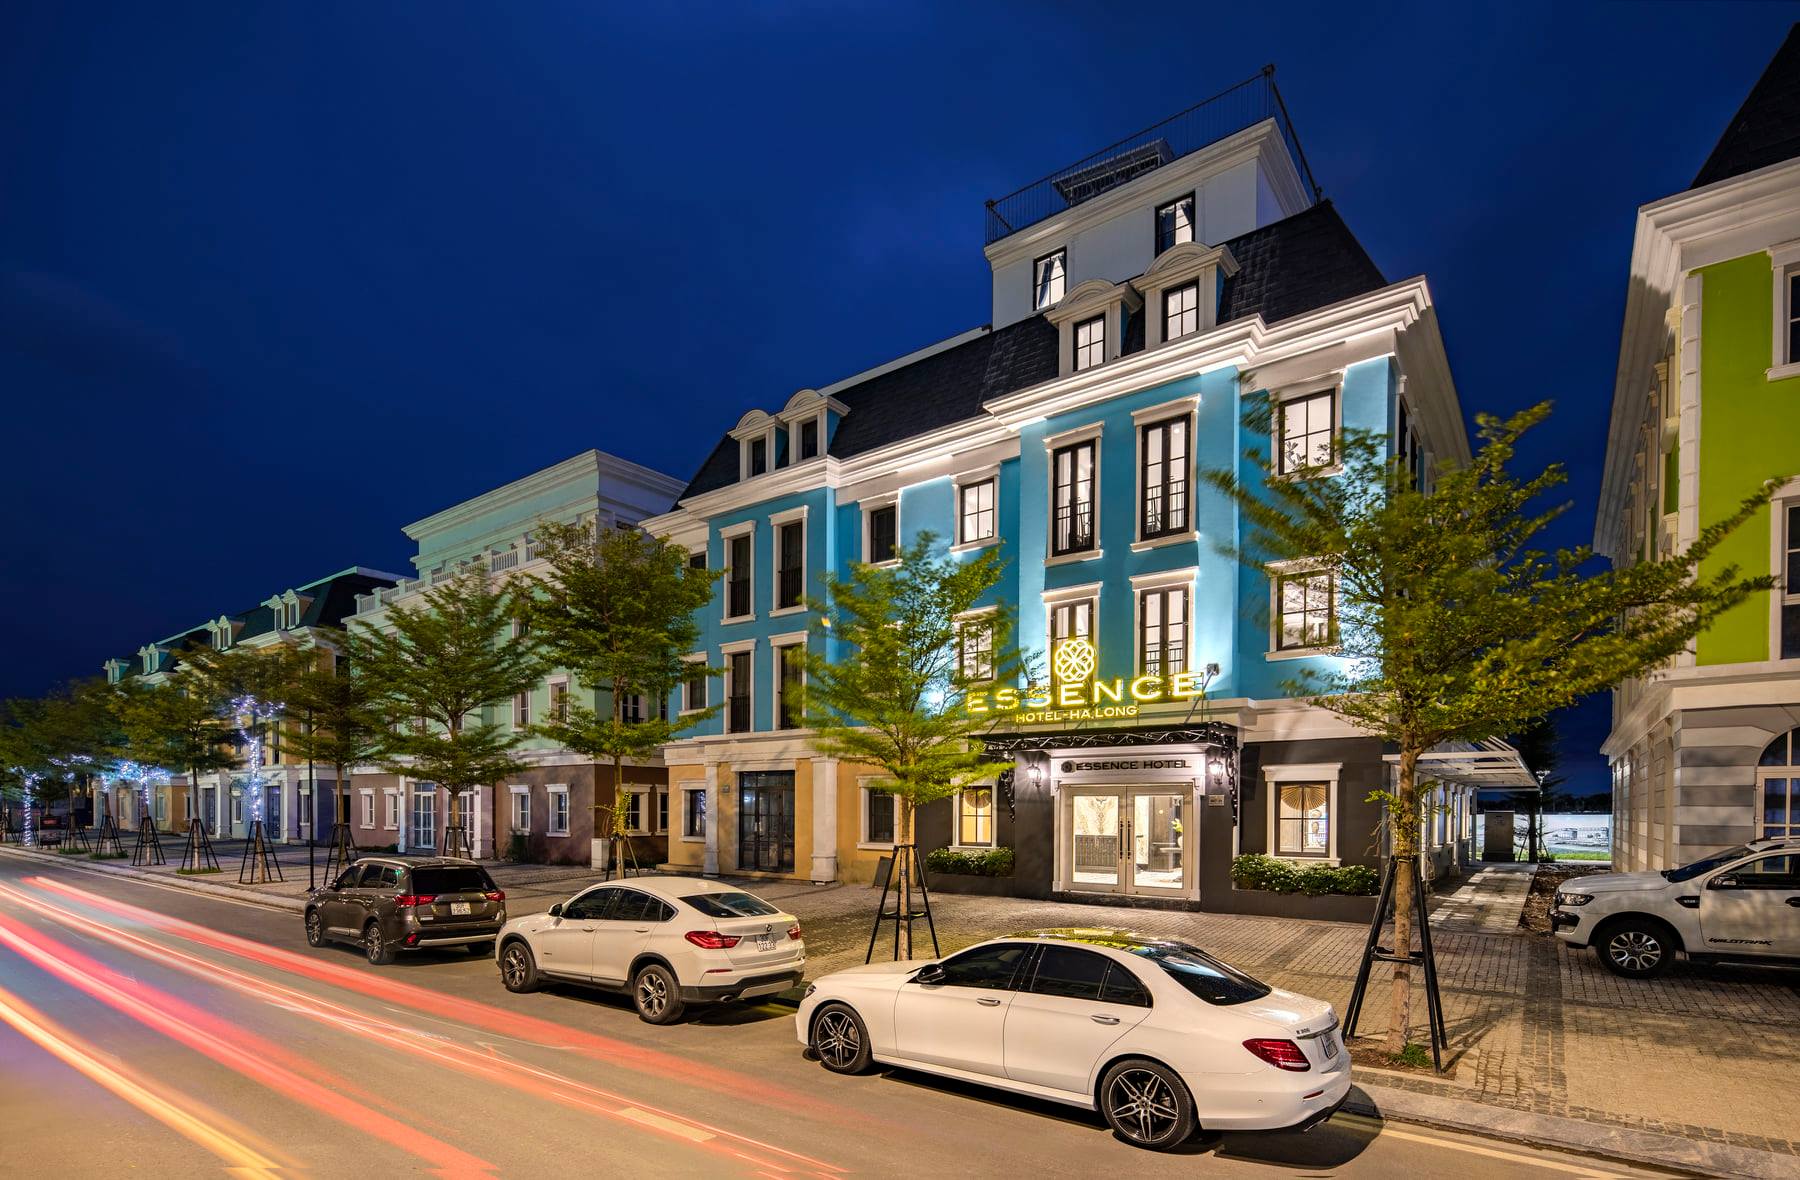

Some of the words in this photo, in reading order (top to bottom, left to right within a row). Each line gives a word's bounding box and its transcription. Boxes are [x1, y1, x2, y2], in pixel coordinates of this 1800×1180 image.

[967, 672, 1204, 712] ESSENCE
[1095, 705, 1138, 718] LONG
[1076, 760, 1139, 771] ESSENCE
[1143, 759, 1192, 769] HOTEL
